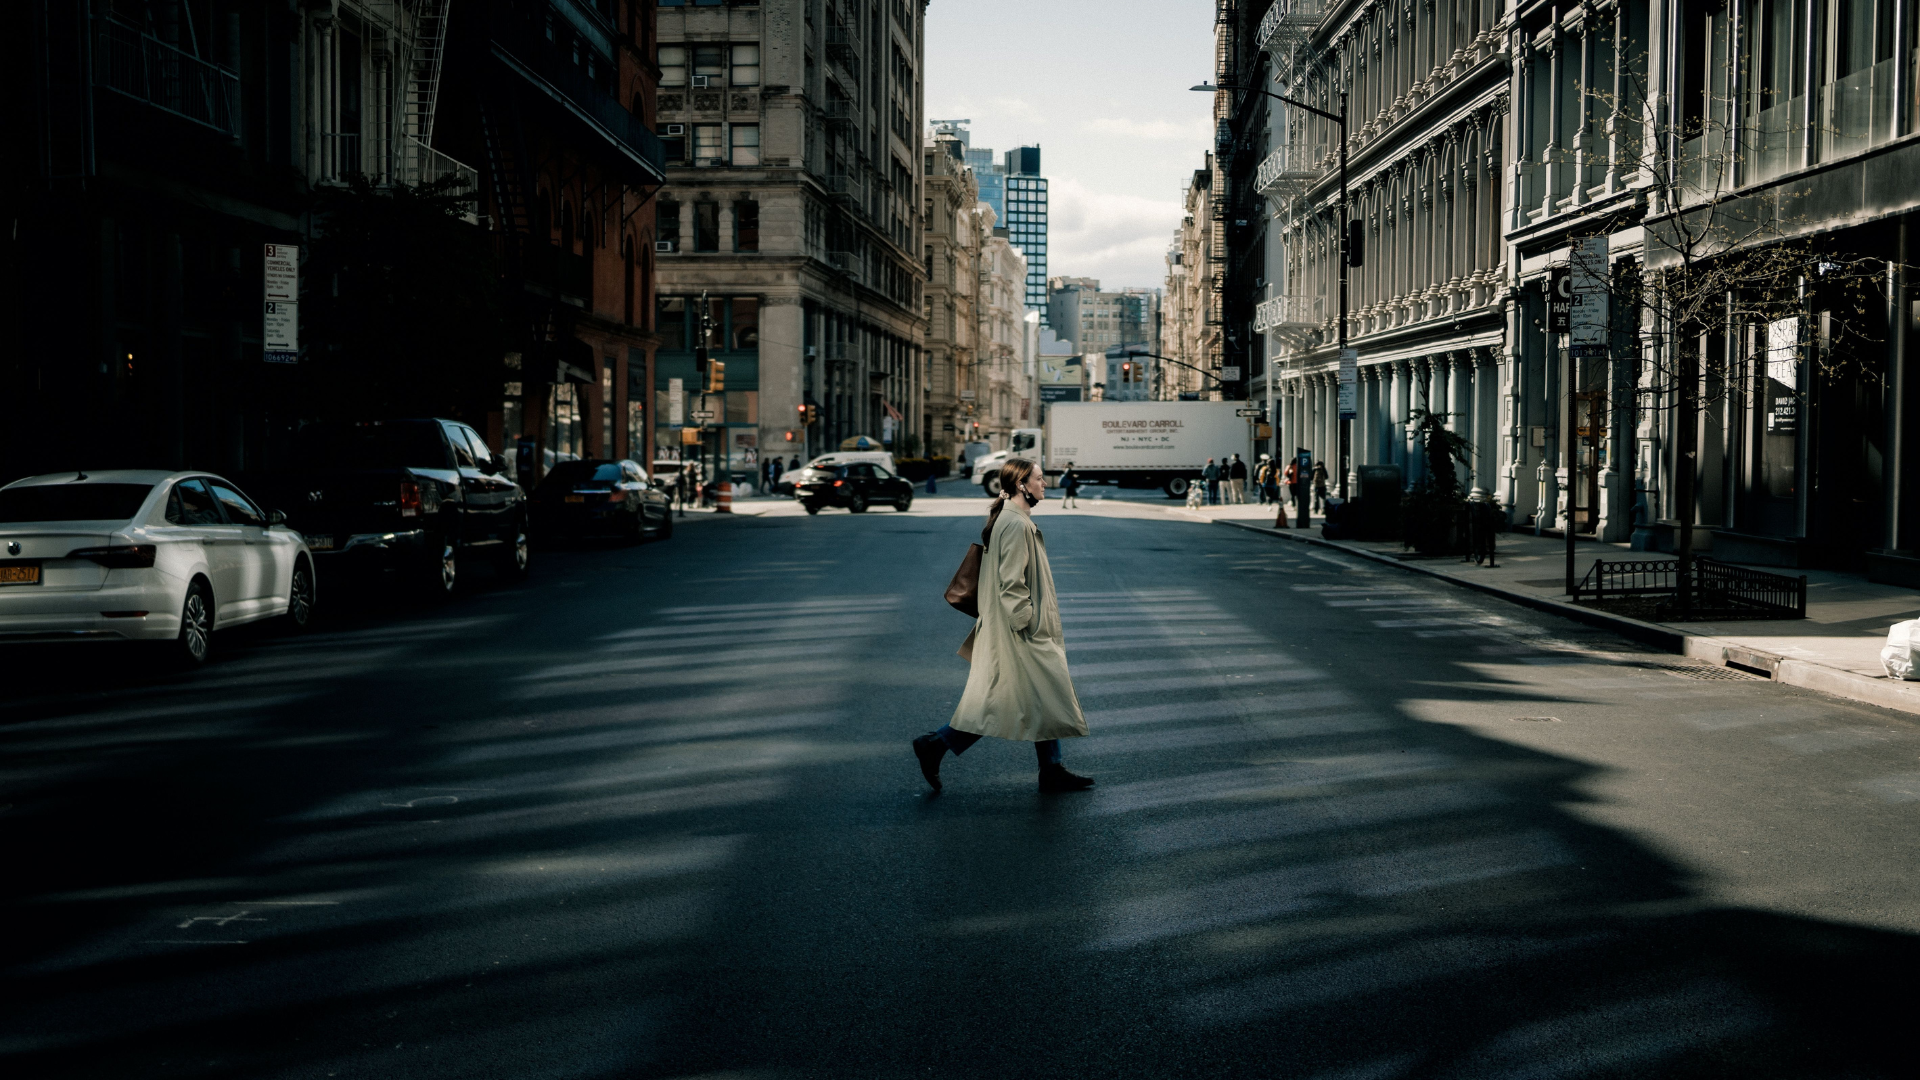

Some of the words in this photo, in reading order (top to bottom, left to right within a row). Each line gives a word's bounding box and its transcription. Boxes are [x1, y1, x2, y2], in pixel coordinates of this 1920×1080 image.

[268, 246, 274, 256] 3
[1574, 295, 1580, 305] 2
[268, 303, 273, 312] 2
